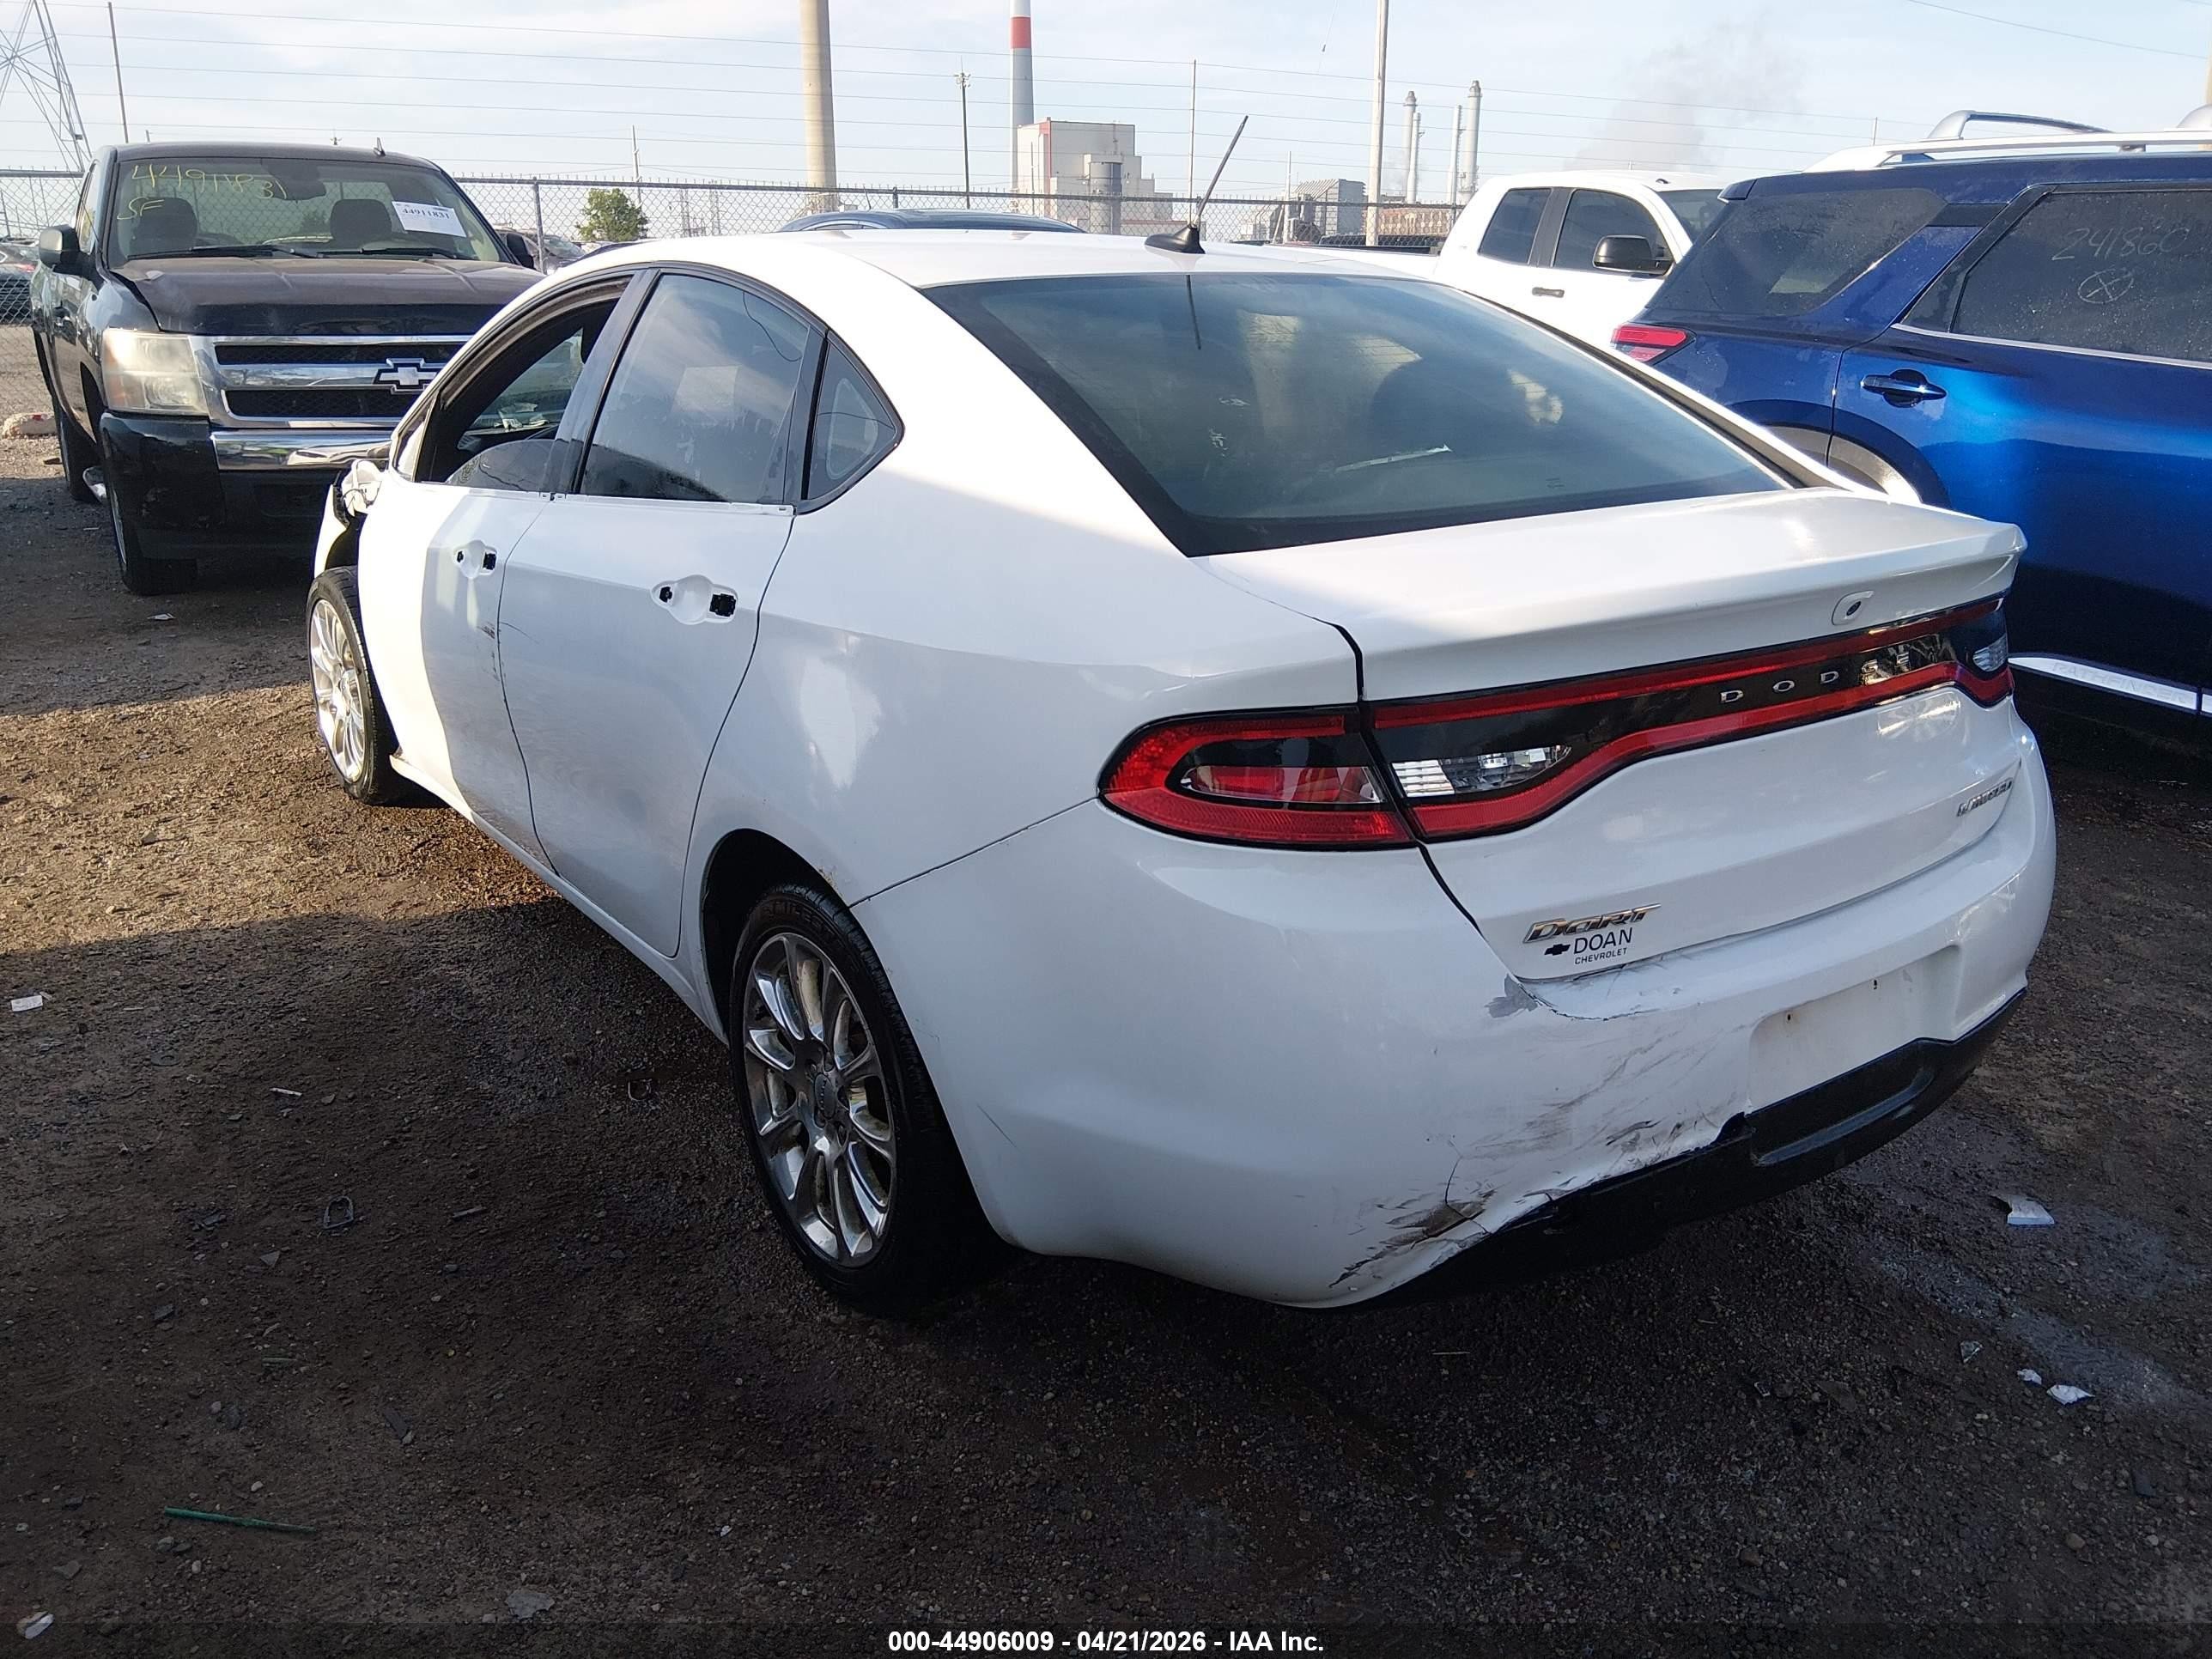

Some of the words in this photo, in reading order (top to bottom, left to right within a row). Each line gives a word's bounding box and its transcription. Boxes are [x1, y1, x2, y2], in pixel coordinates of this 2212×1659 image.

[402, 208, 450, 220] 44911831
[1720, 652, 1911, 703] DODGE
[1573, 927, 1633, 955] DOAN
[1574, 947, 1628, 965] CHEVROLET
